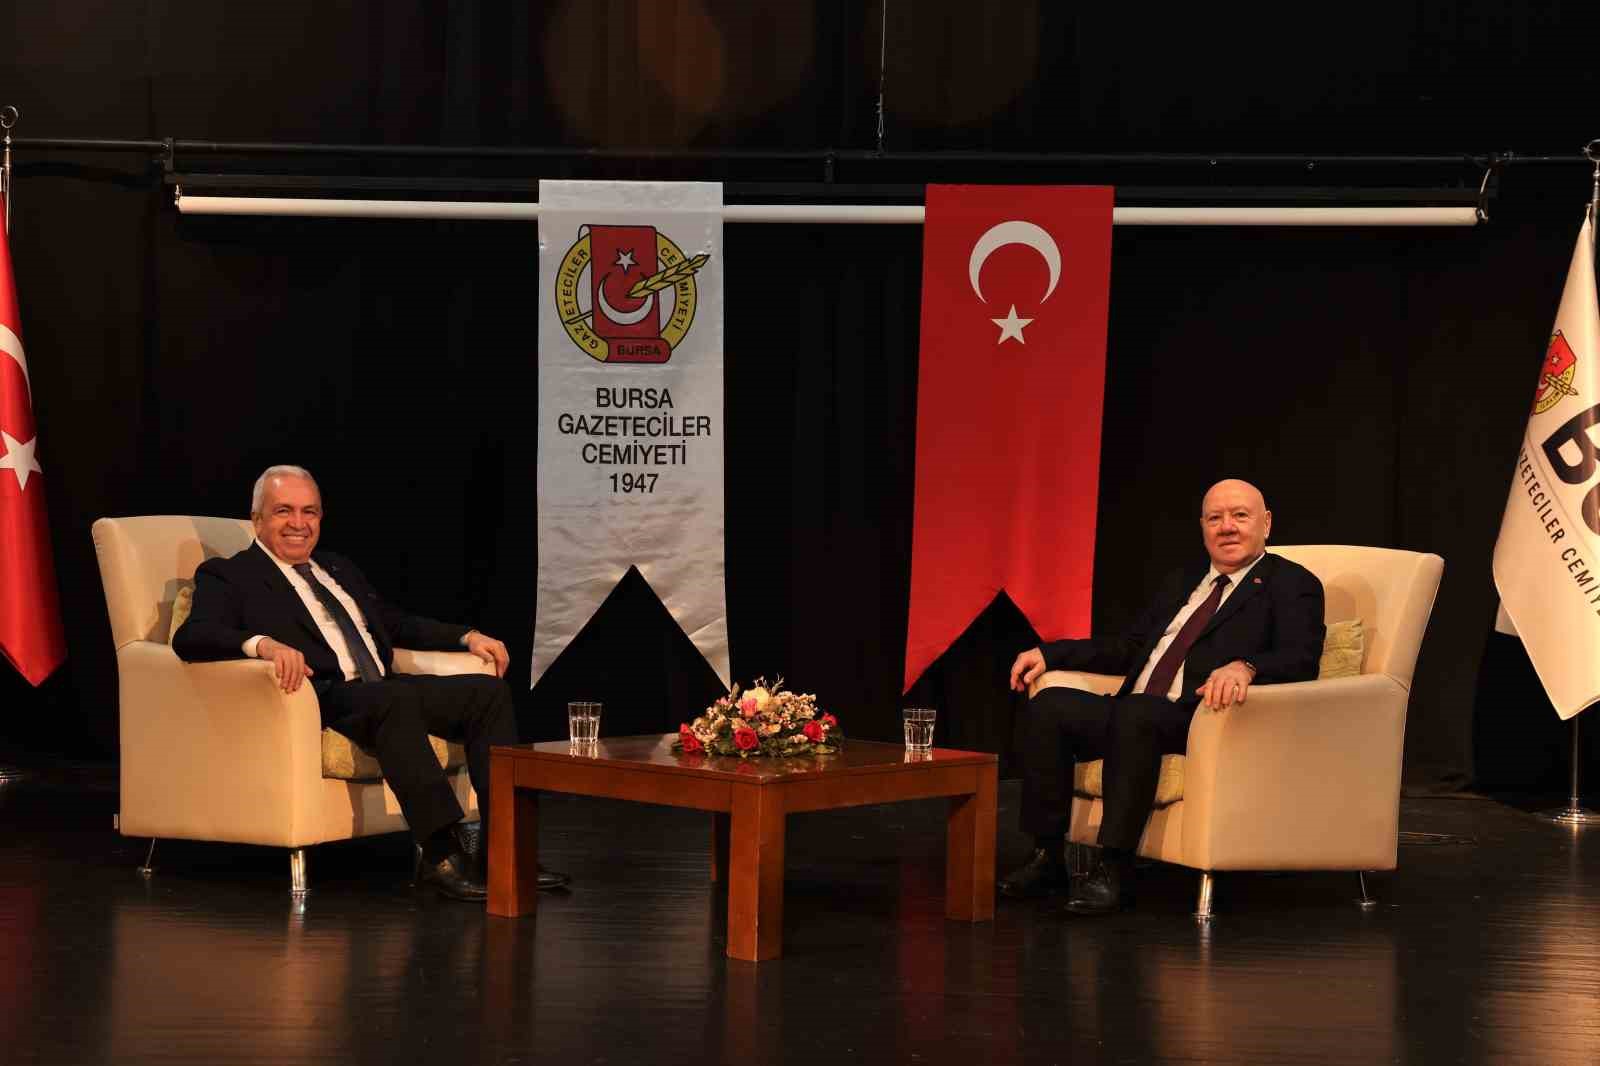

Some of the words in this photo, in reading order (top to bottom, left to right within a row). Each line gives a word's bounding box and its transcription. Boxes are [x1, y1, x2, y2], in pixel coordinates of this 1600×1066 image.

[617, 344, 662, 357] BURSA
[596, 387, 674, 409] BURSA
[558, 412, 711, 437] GAZETECİLER
[582, 439, 686, 465] CEMİYETİ
[609, 472, 659, 494] 1947
